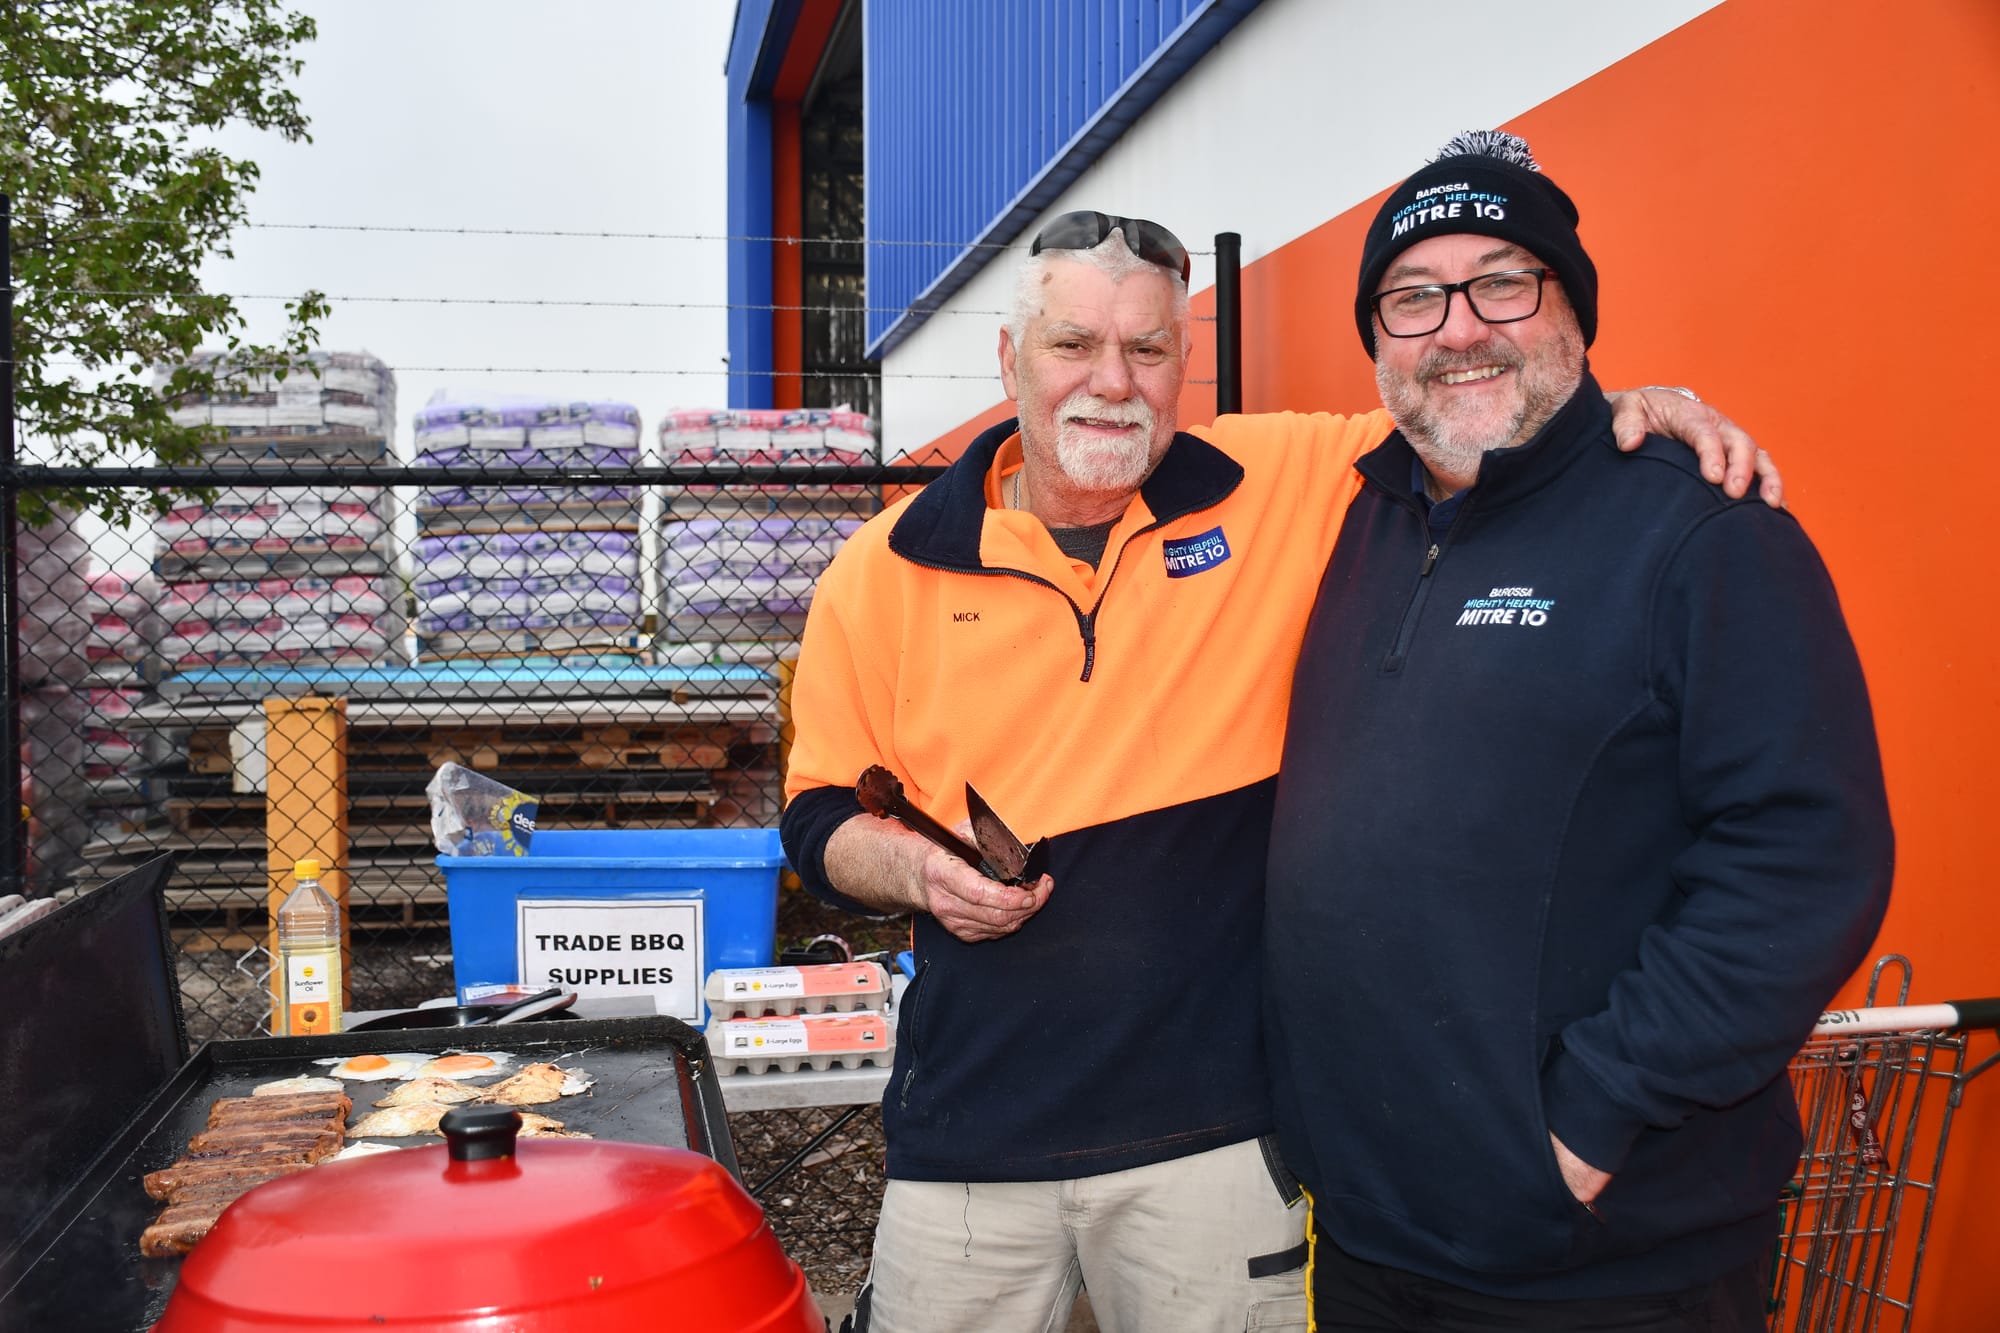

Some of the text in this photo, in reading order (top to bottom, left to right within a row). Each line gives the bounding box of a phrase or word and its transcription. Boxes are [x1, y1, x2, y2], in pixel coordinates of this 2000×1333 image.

[1415, 182, 1470, 200] BAROSSA
[1392, 196, 1438, 223] MIGHTY
[1391, 202, 1505, 240] MITRE 10
[1187, 535, 1223, 554] HELPFUL
[1165, 544, 1225, 571] MITRE 10
[1488, 587, 1534, 598] BAROSSA
[1463, 599, 1553, 610] MIGHTY HELPFUL
[953, 612, 981, 623] MICK
[1455, 608, 1548, 626] MITRE 10
[535, 933, 685, 951] TRADE BBQ
[548, 967, 674, 985] SUPPLIES
